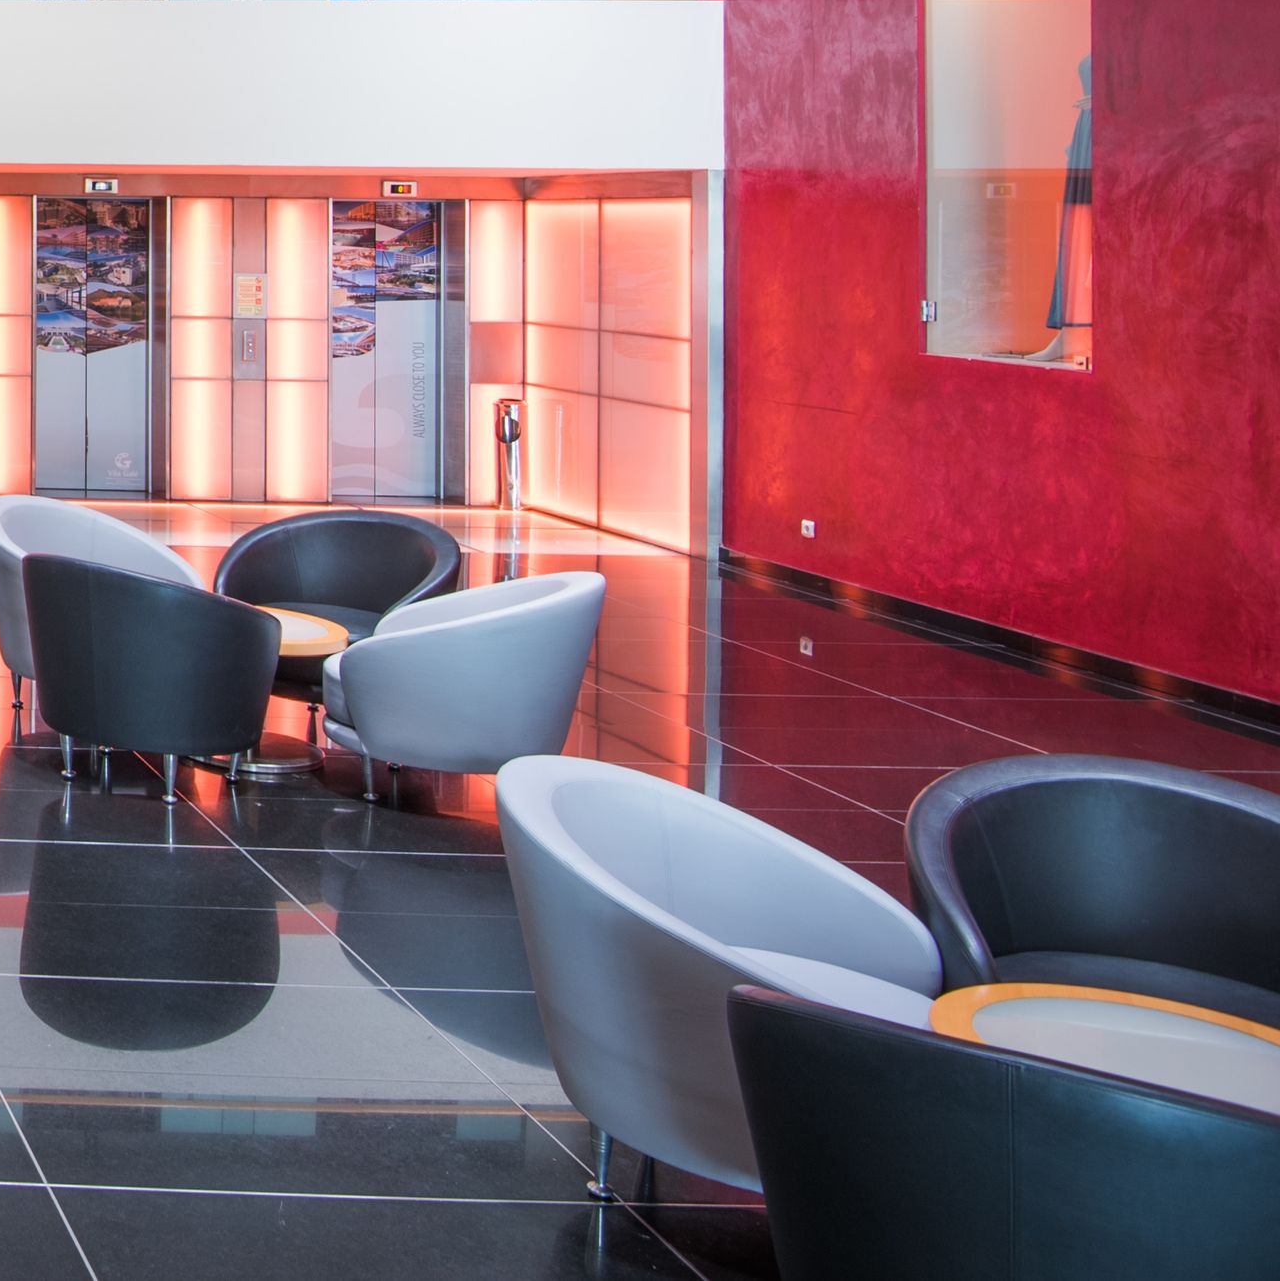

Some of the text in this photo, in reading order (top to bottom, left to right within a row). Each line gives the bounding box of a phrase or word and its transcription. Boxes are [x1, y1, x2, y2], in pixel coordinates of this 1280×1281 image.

[412, 342, 425, 439] ALWAYS CLOSE TO YOU
